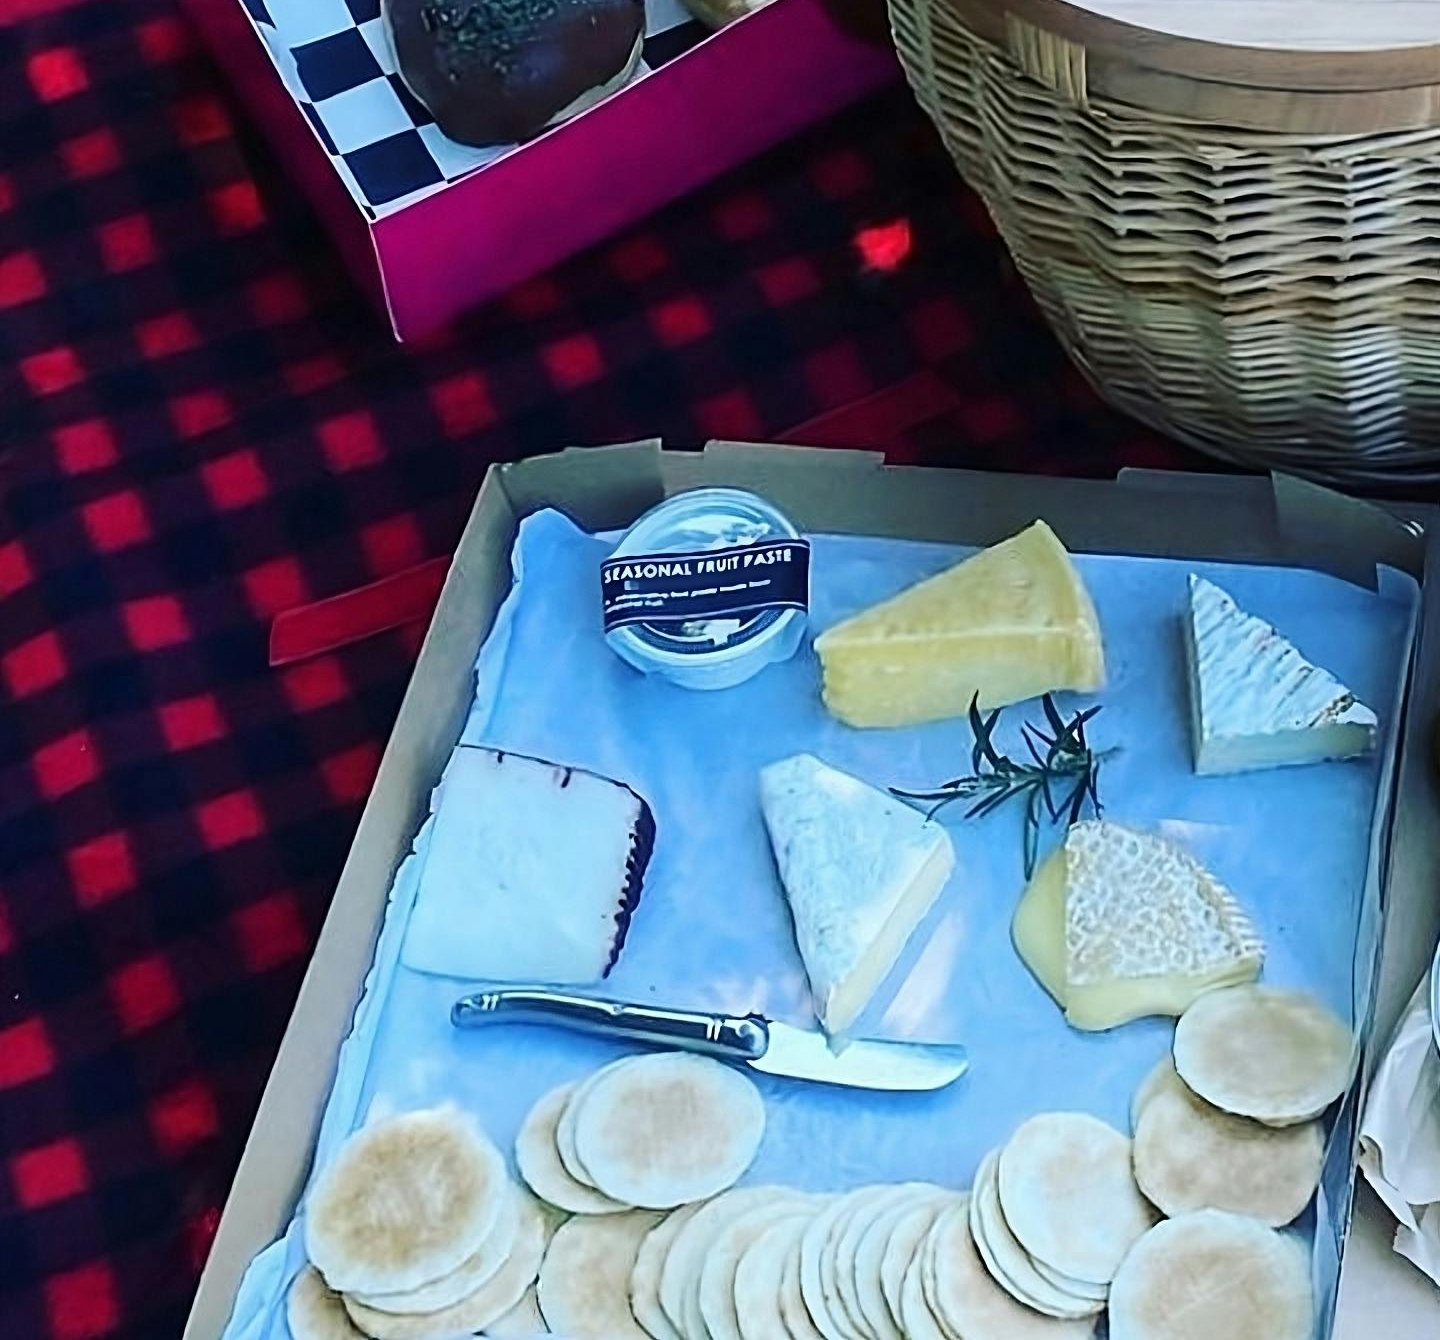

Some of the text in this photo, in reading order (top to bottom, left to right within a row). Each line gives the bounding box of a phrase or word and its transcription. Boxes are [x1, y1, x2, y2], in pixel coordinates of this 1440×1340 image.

[604, 548, 792, 584] SEASONAL FRUIT PASTE
